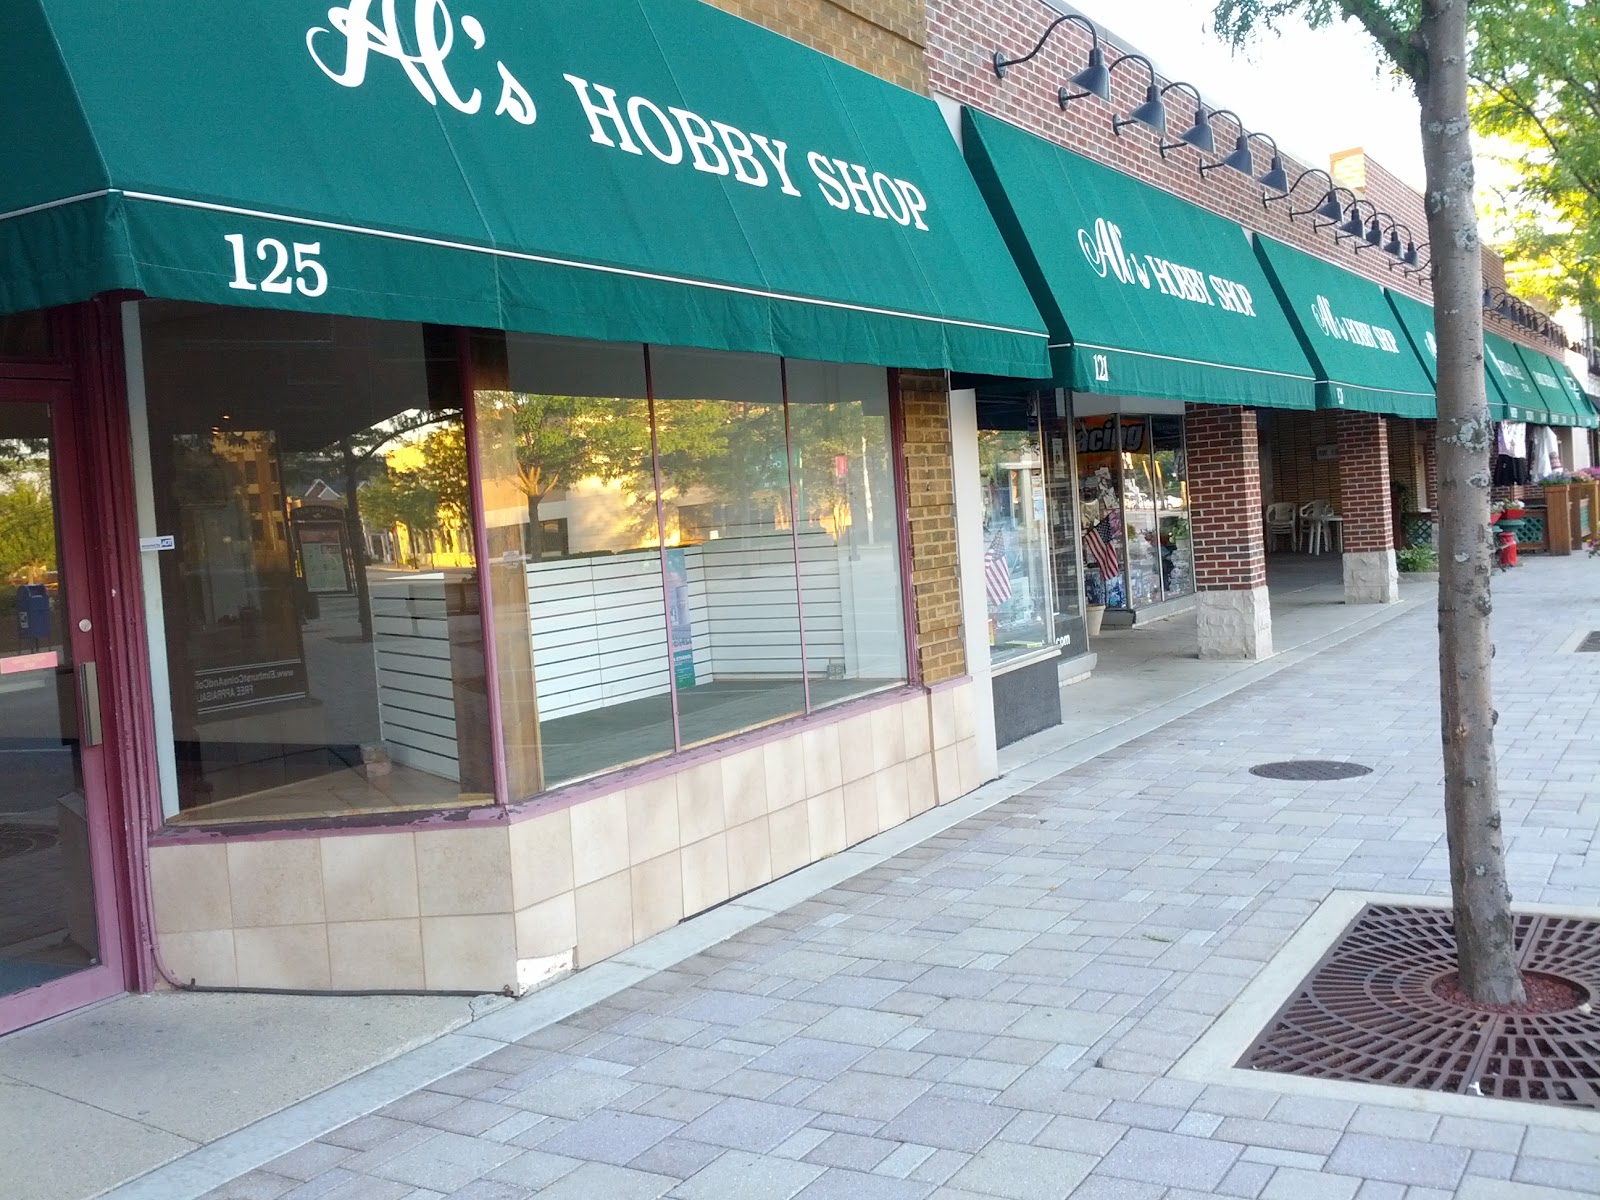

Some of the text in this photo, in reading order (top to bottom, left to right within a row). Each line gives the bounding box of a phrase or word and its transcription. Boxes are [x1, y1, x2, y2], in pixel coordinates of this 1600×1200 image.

[306, 0, 930, 232] Al's HOBBY SHOP
[223, 233, 328, 297] 125
[1078, 217, 1257, 318] Al's HOBBY SHOP
[1092, 353, 1109, 381] 121
